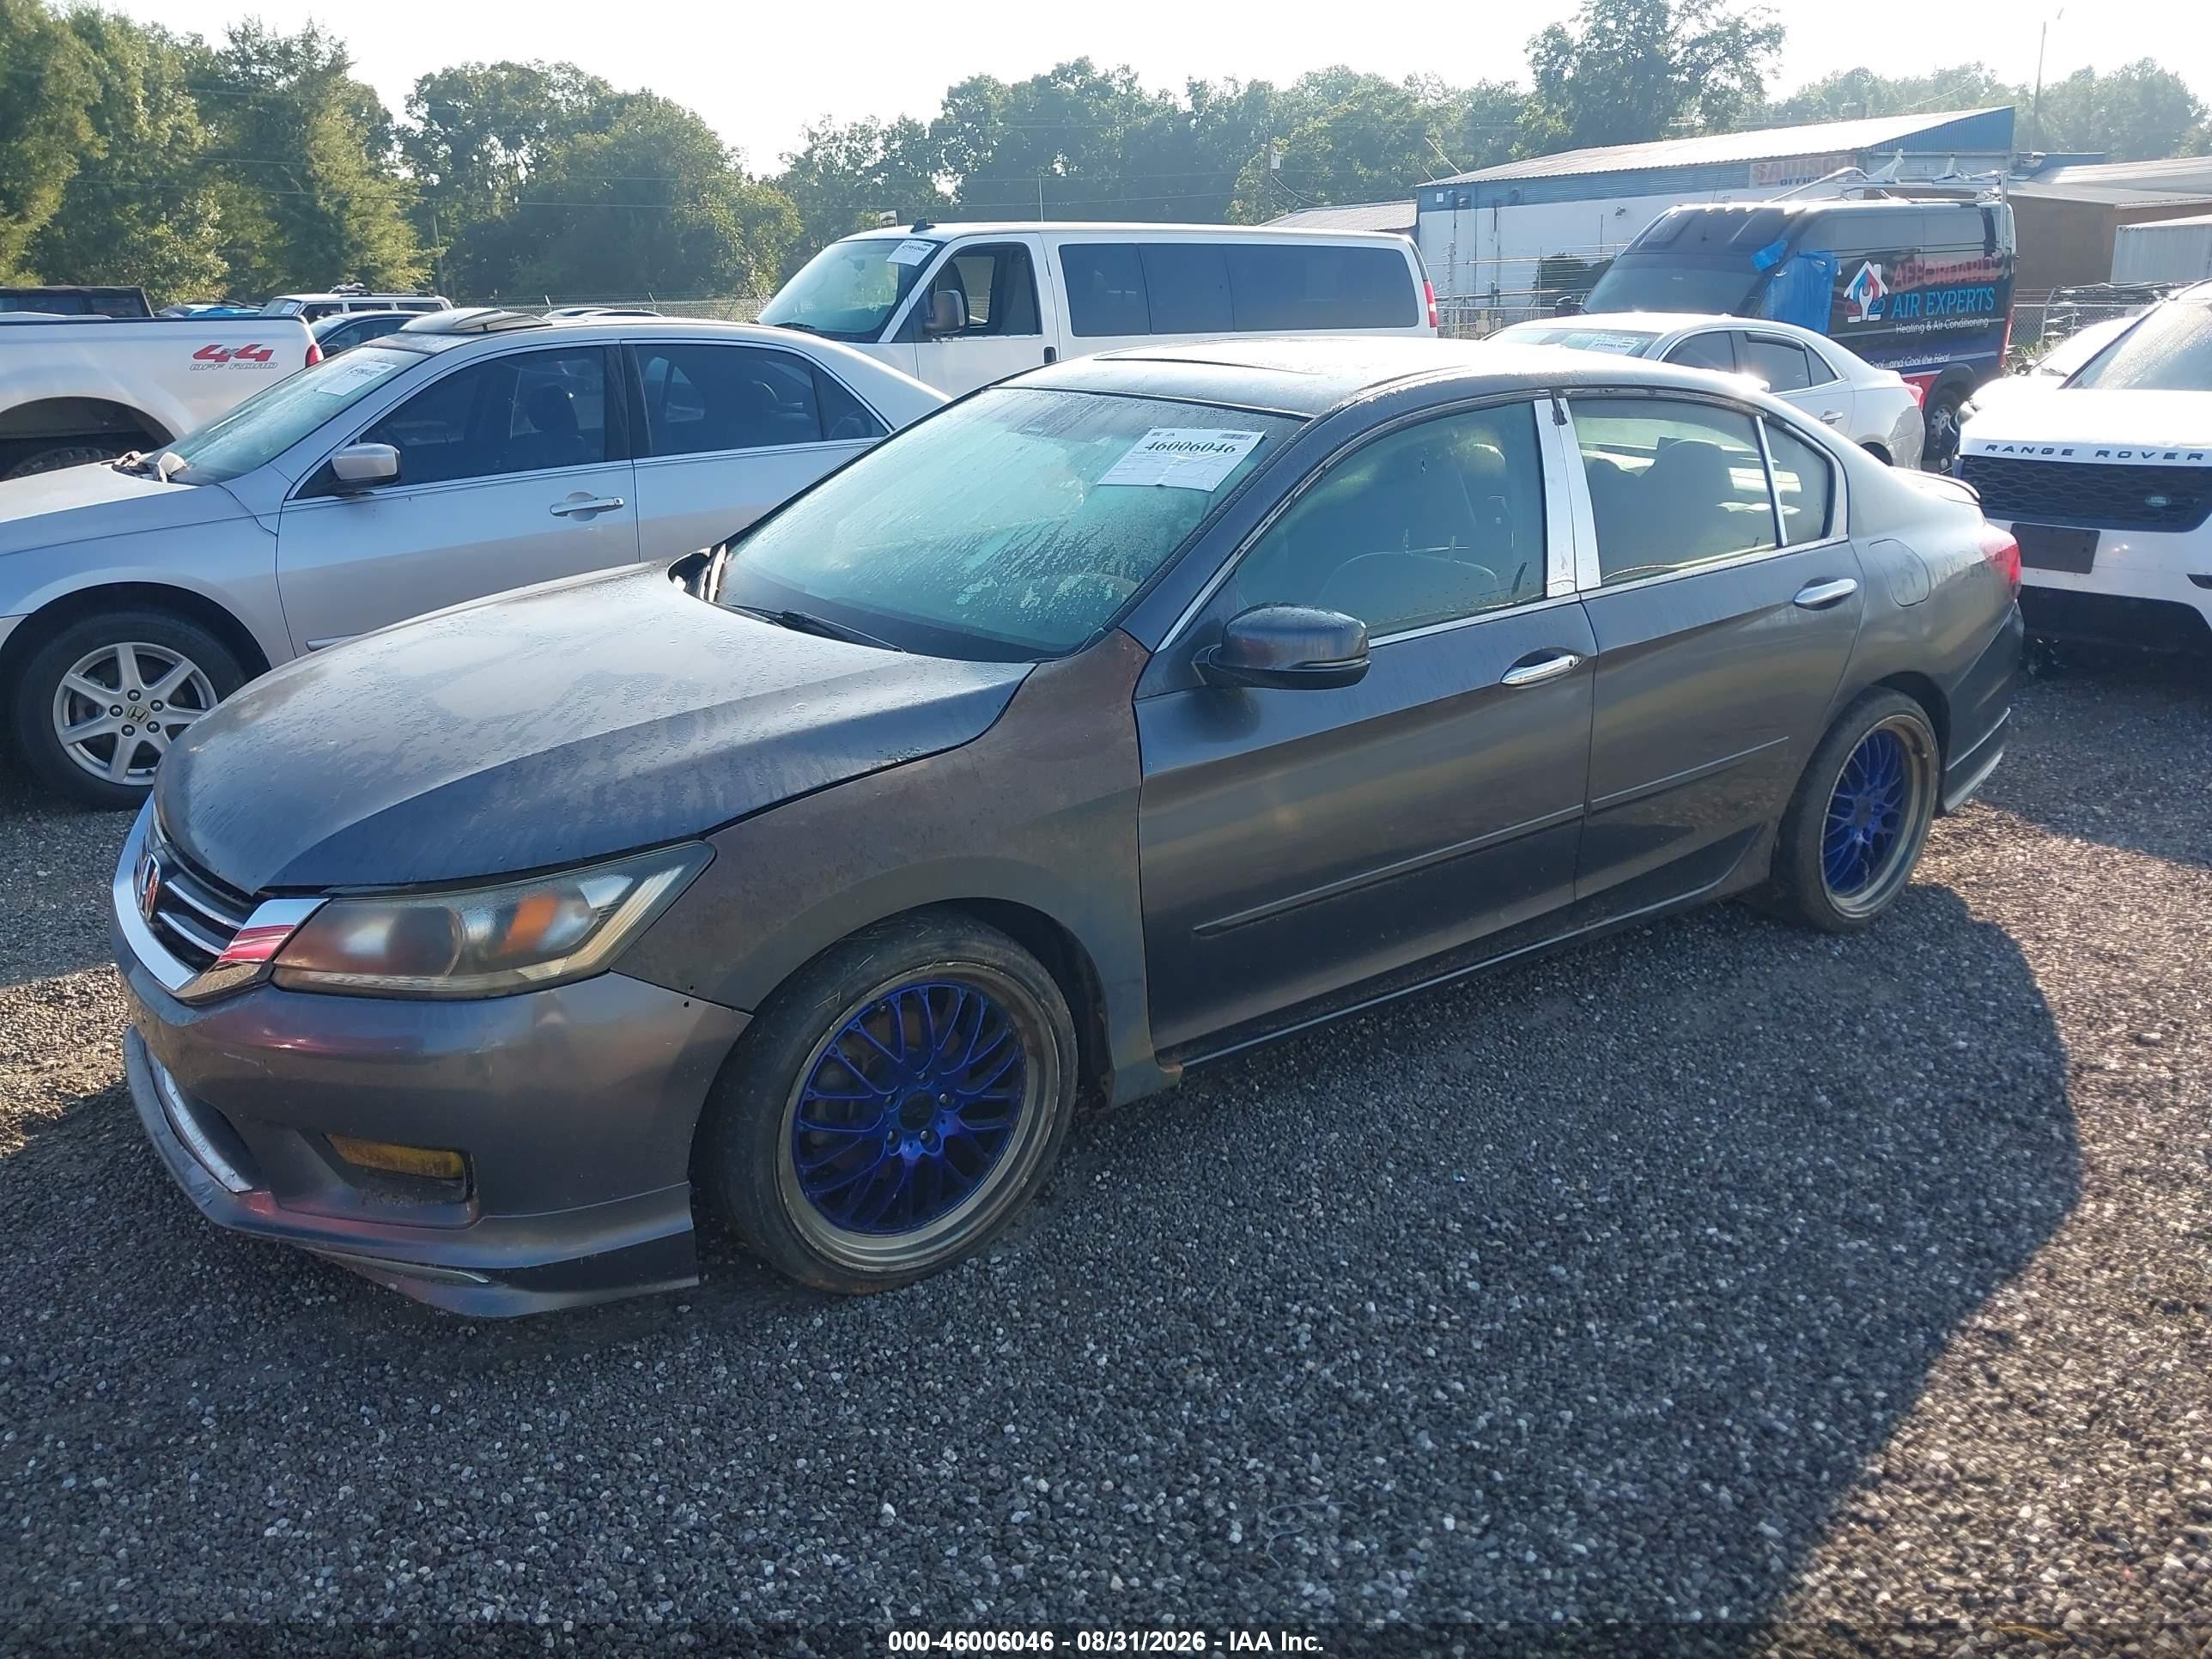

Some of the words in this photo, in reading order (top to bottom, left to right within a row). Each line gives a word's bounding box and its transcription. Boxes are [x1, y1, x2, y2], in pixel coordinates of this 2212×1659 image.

[1891, 292, 1921, 319] AIR
[1926, 287, 1996, 317] EXPERTS
[1896, 323, 1925, 335] Heating
[1926, 321, 1932, 331] &
[1933, 319, 1943, 331] Air
[1944, 317, 1990, 330] Conditioning
[192, 343, 275, 362] 4x4
[1889, 356, 1903, 368] and
[1905, 355, 1921, 368] Cool
[1922, 355, 1933, 364] the
[1934, 353, 1950, 363] Heat
[228, 362, 278, 370] ROAD
[1145, 441, 1237, 453] 46006046
[1984, 443, 2075, 457] RANGE
[2094, 449, 2205, 461] ROVER
